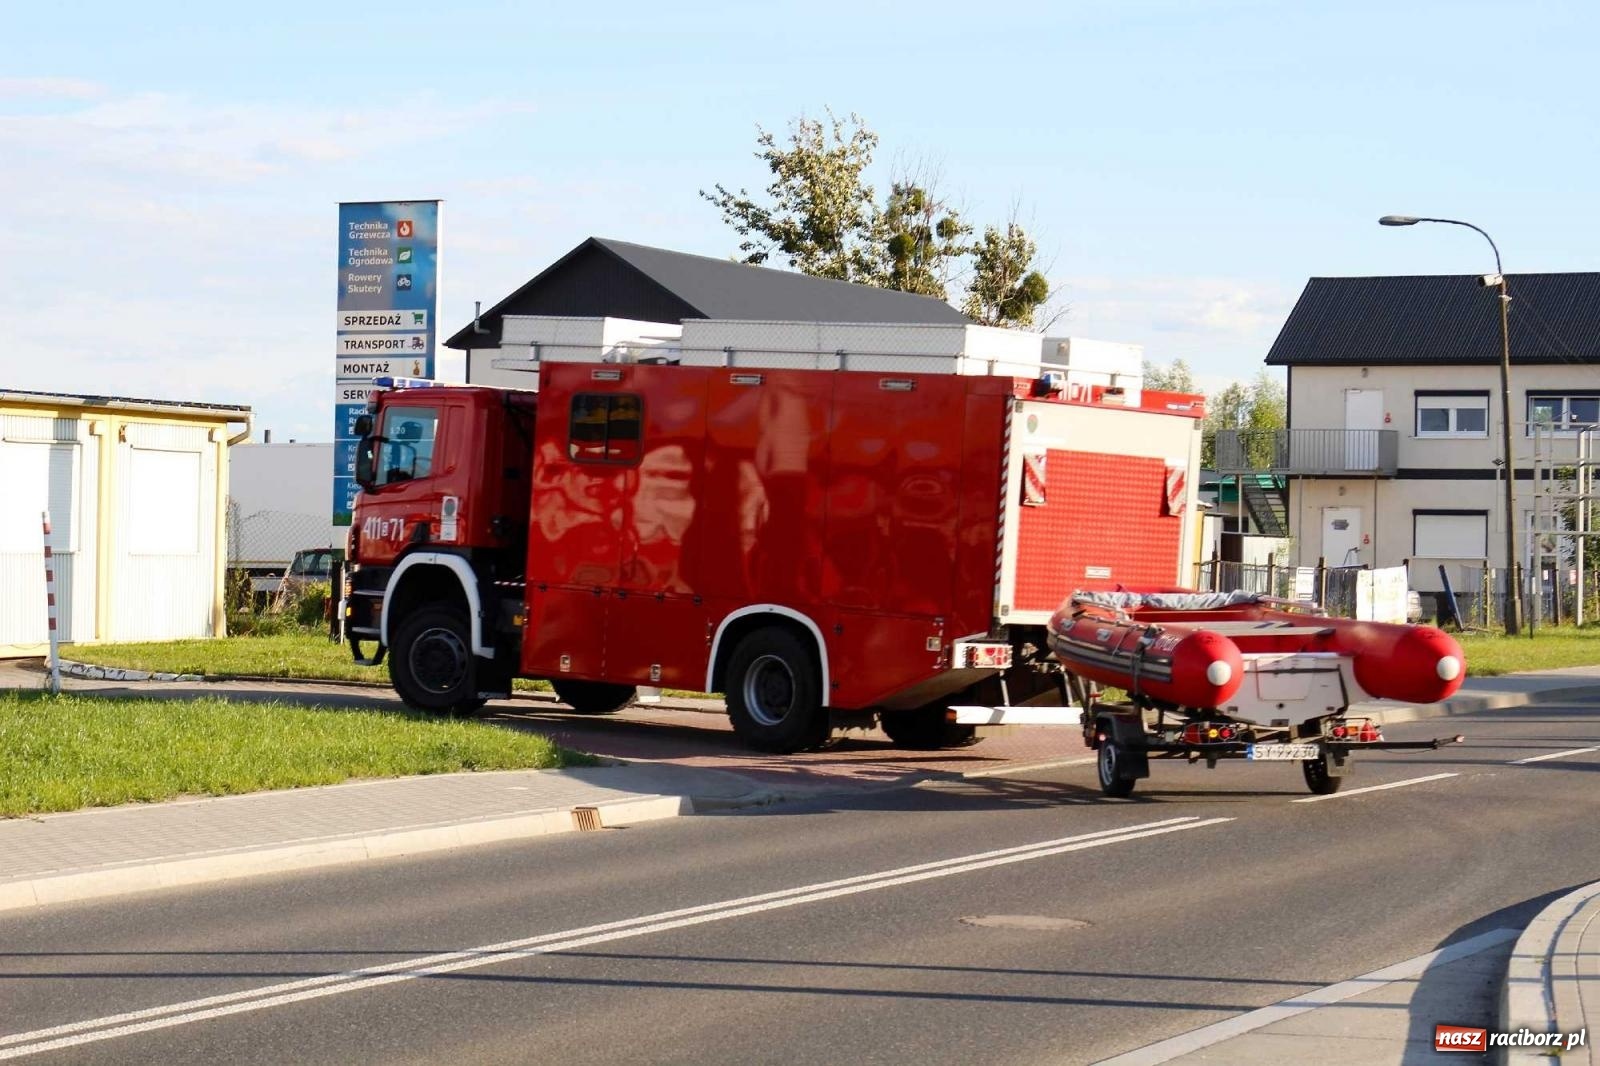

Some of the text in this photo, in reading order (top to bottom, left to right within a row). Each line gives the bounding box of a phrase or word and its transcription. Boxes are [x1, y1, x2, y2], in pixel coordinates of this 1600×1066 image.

[348, 222, 389, 230] Technika
[348, 231, 391, 239] Grzewcza
[348, 248, 388, 256] Technika
[348, 257, 393, 267] Ogrodowa
[348, 273, 382, 283] Rowery
[347, 285, 383, 294] Skutery
[344, 313, 402, 326] SPRZEDAŻ
[344, 339, 406, 349] TRANSPORT
[343, 361, 390, 373] MONTAŻ
